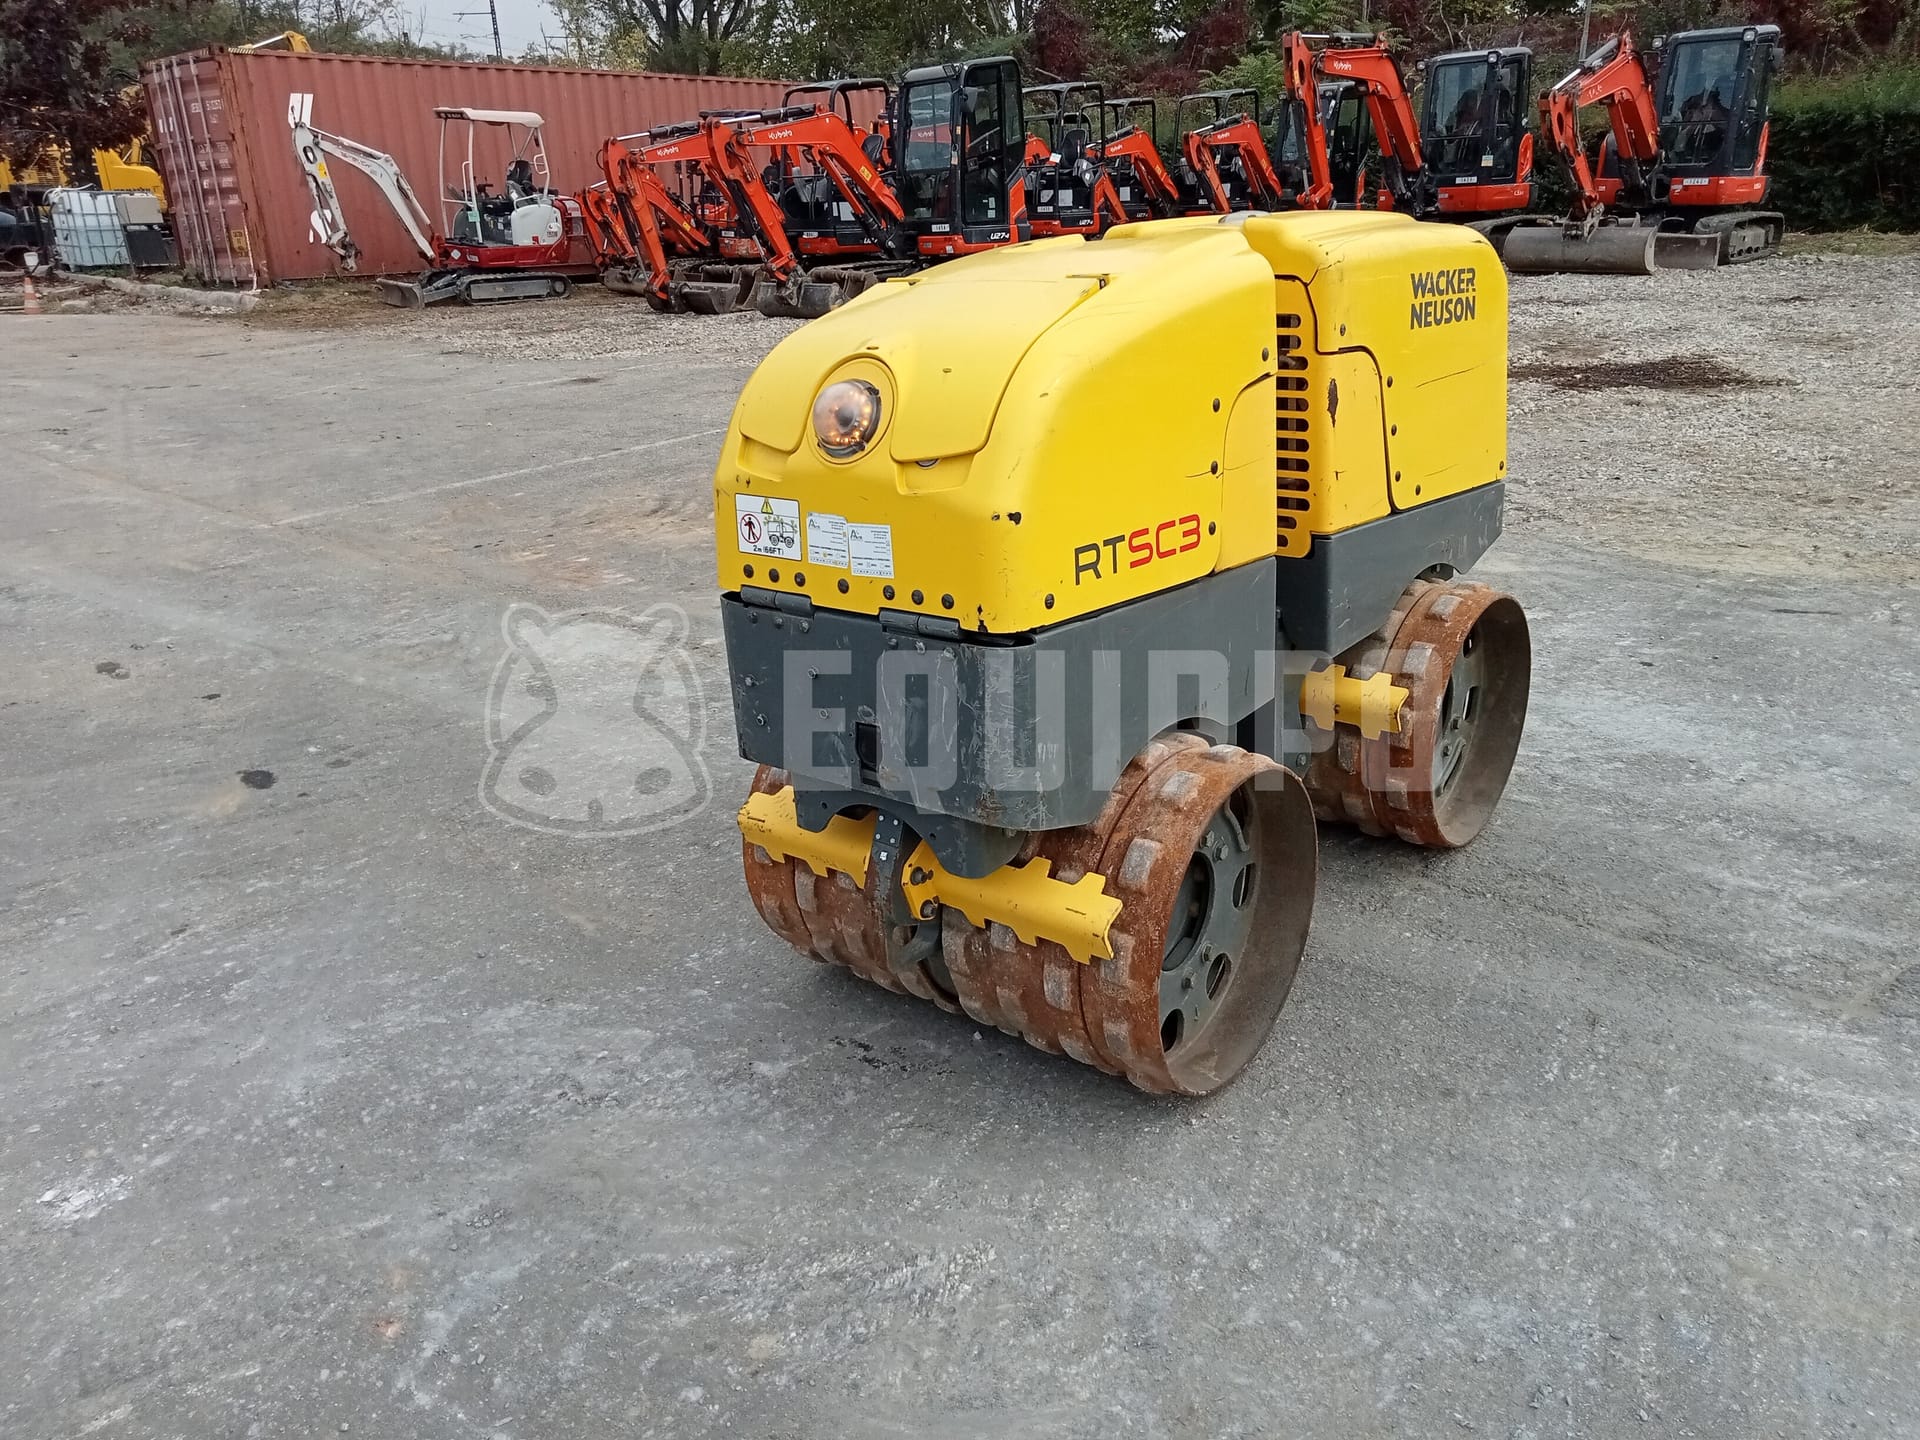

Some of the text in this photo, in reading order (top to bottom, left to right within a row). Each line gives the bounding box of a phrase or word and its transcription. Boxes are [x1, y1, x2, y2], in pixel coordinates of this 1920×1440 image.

[768, 129, 793, 140] Kubota
[656, 146, 679, 157] Kubota
[1410, 267, 1476, 300] WACKER
[1410, 296, 1476, 330] NEUSON
[1074, 513, 1201, 586] RTSC3
